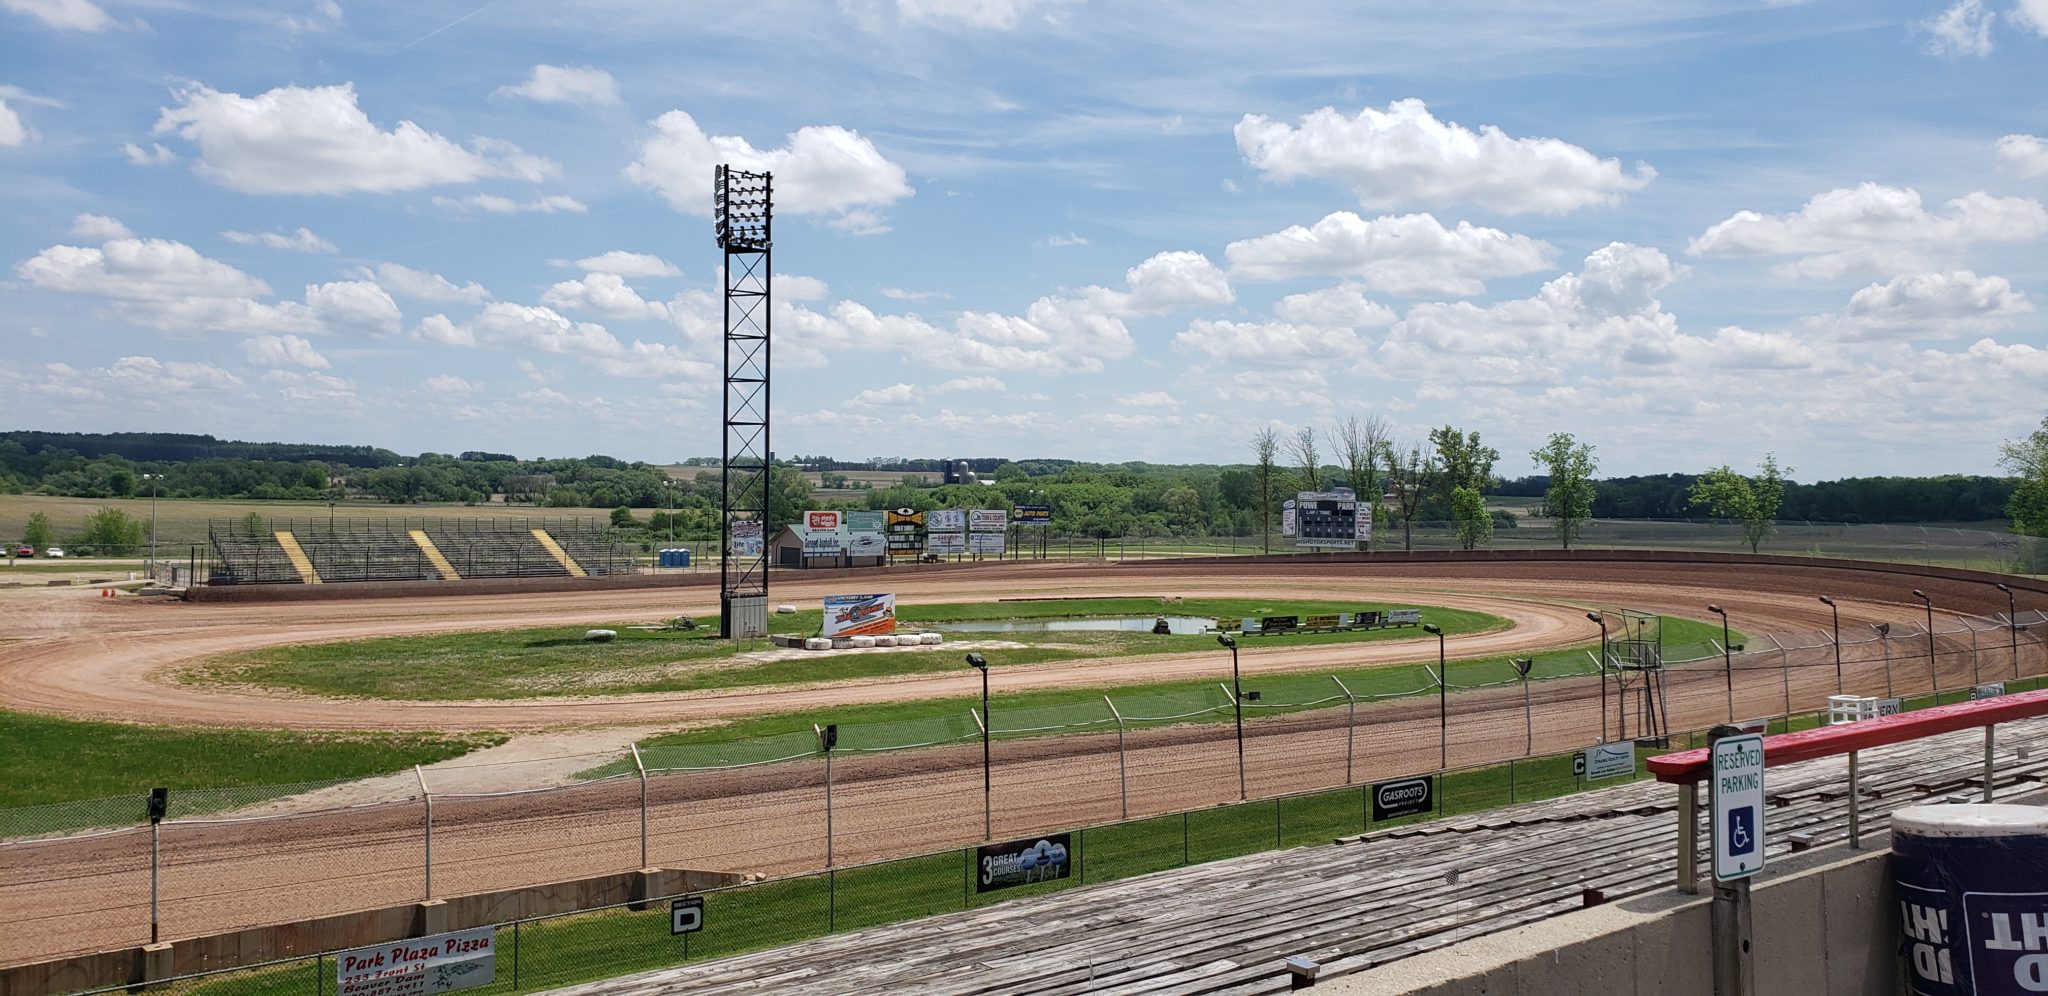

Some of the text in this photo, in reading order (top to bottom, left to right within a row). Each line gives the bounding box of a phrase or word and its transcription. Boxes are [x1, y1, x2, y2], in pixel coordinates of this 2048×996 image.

[1574, 758, 1584, 773] C
[1719, 749, 1760, 771] RESERVED
[1722, 772, 1758, 794] PARKING
[1383, 787, 1423, 802] GASROOTS
[993, 853, 1017, 866] GREAT
[983, 856, 992, 884] 3
[994, 864, 1020, 876] COURSES
[674, 906, 701, 932] D
[345, 937, 489, 972] Park Plaza Pizza
[375, 966, 408, 977] Front
[414, 963, 425, 971] St
[344, 980, 390, 993] Beaver
[396, 974, 424, 984] Dam
